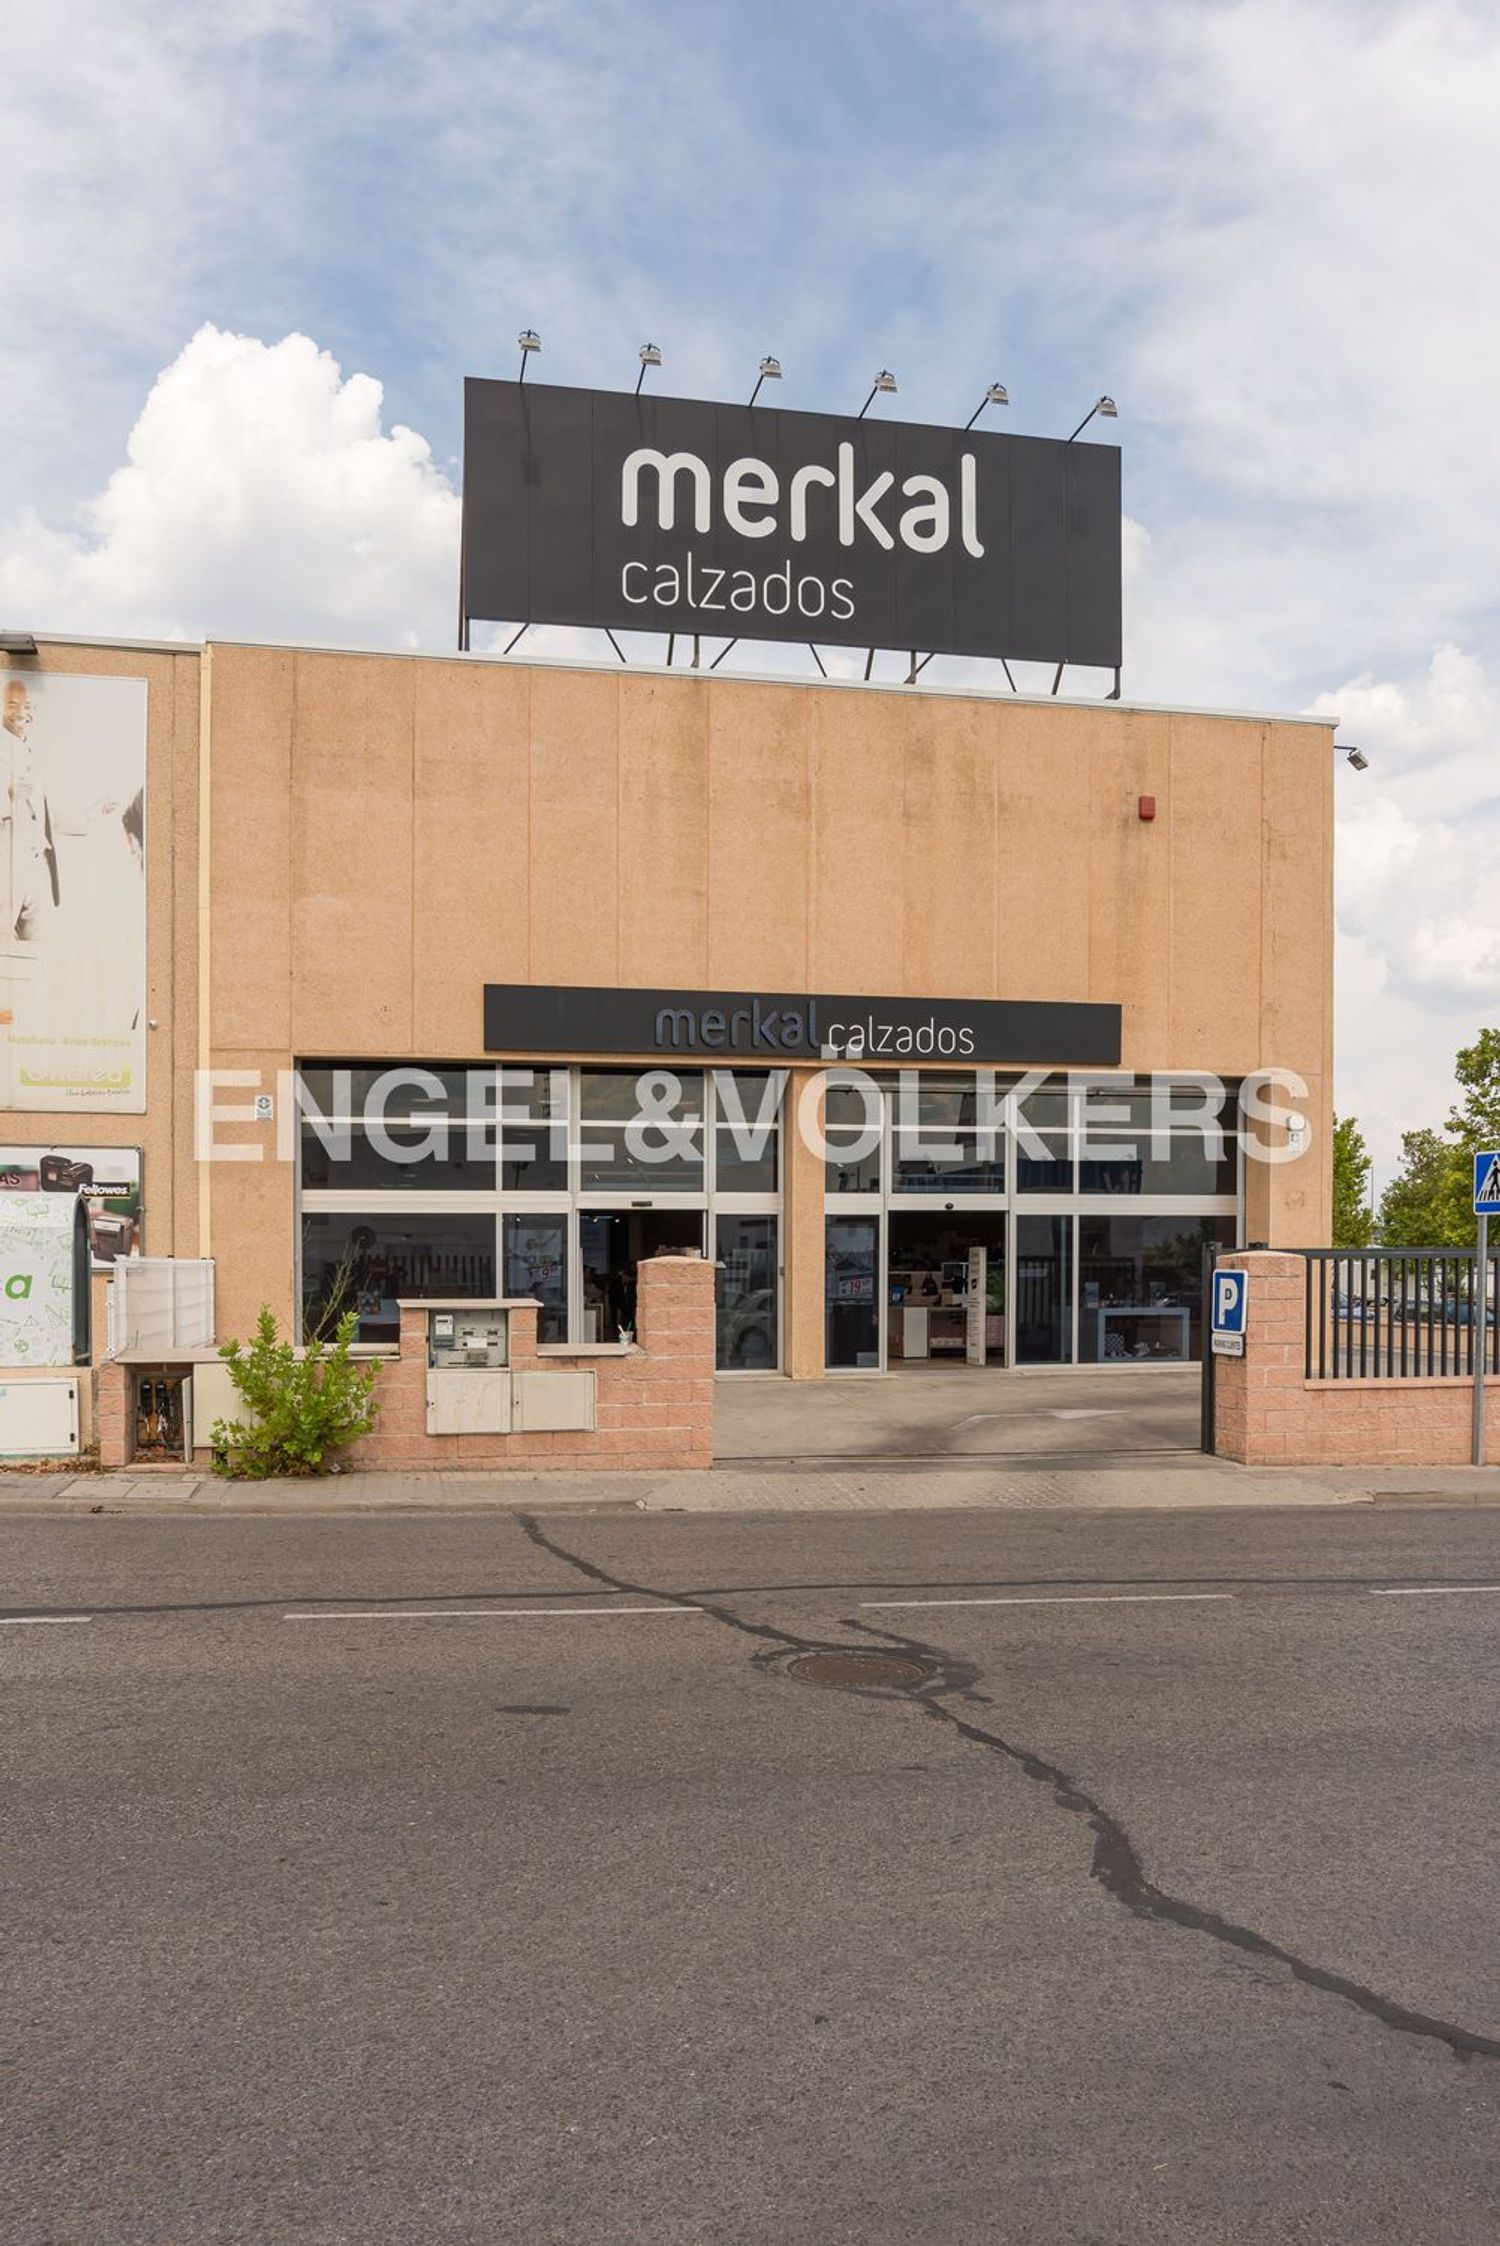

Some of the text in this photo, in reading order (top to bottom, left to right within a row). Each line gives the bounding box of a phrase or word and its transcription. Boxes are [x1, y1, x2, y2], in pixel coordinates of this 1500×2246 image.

[621, 441, 984, 558] merkal
[621, 551, 855, 620] calzados
[655, 998, 975, 1054] merkal calzados
[79, 1183, 128, 1196] Fellowes
[1218, 1278, 1238, 1325] P
